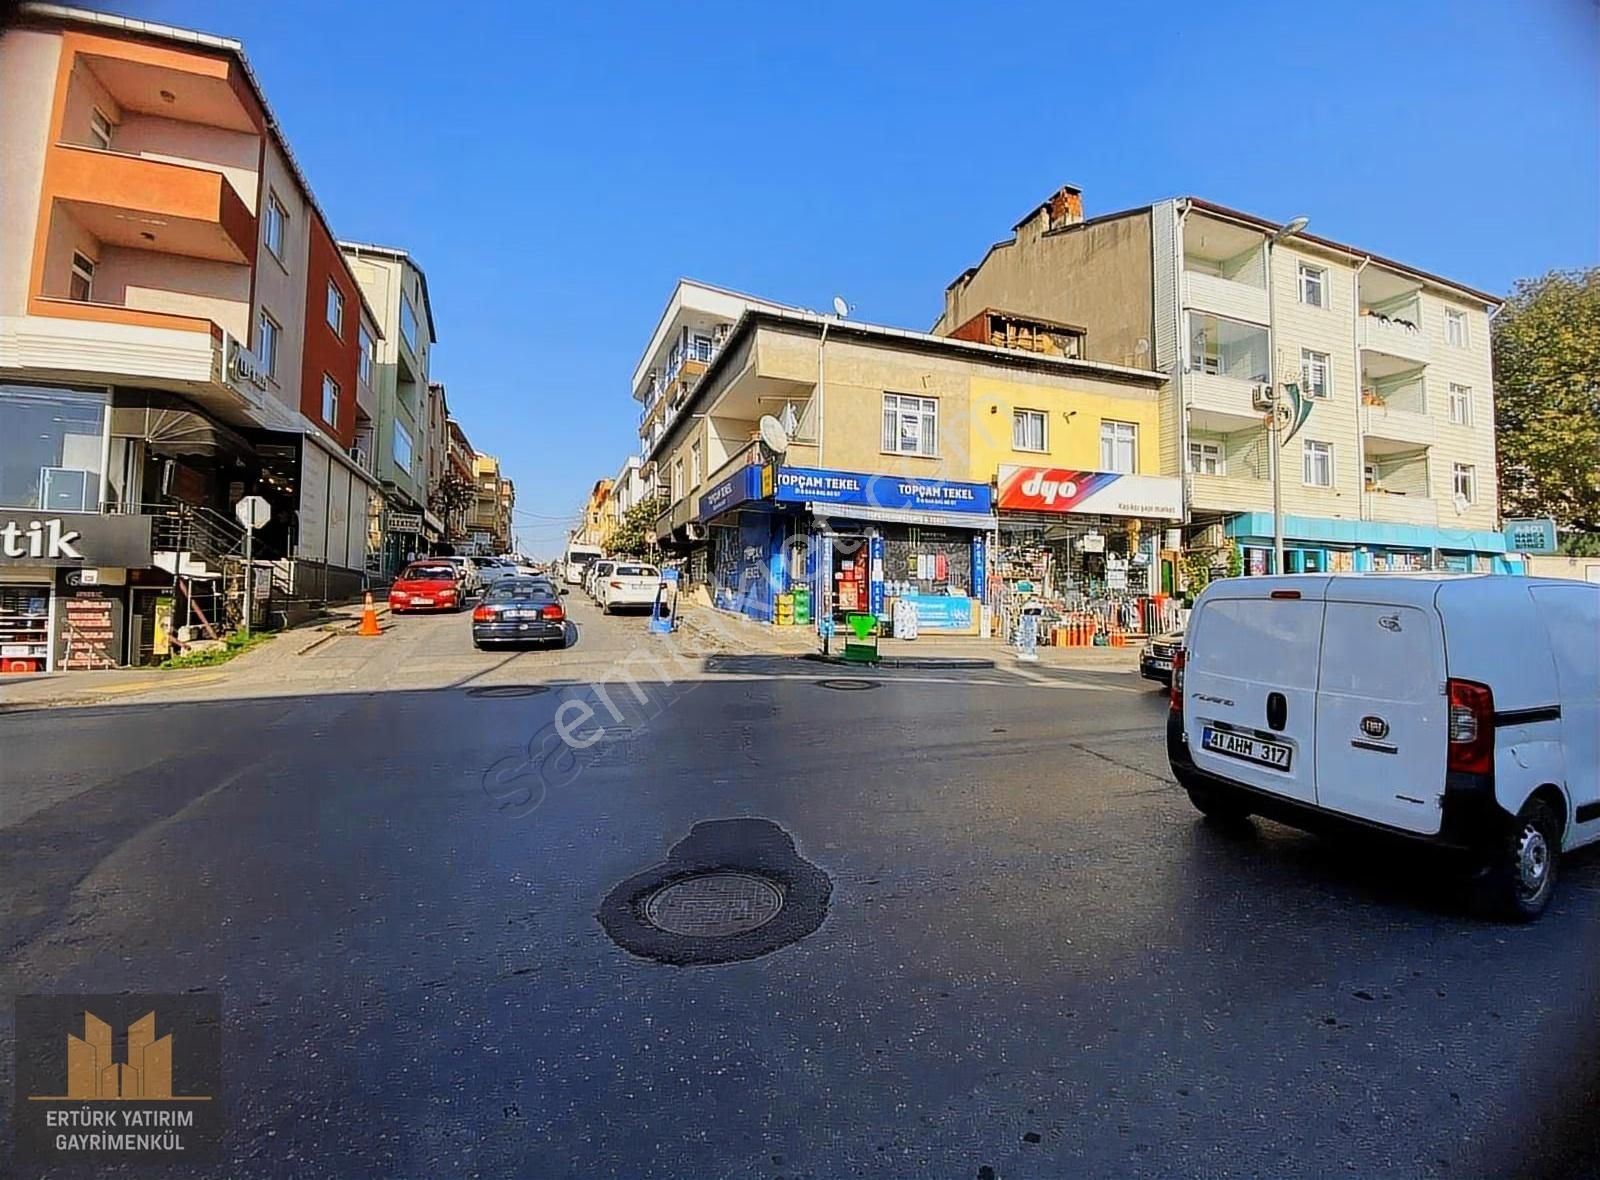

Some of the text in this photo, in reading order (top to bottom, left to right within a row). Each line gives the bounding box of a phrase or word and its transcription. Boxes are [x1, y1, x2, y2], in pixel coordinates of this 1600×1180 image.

[777, 474, 823, 488] TOPÇAM
[824, 477, 860, 491] TEKEL
[898, 484, 974, 500] TOPÇAM TEKEL
[1021, 472, 1077, 504] dyo
[0, 519, 84, 558] tik
[1210, 731, 1287, 763] 41 AHM 317
